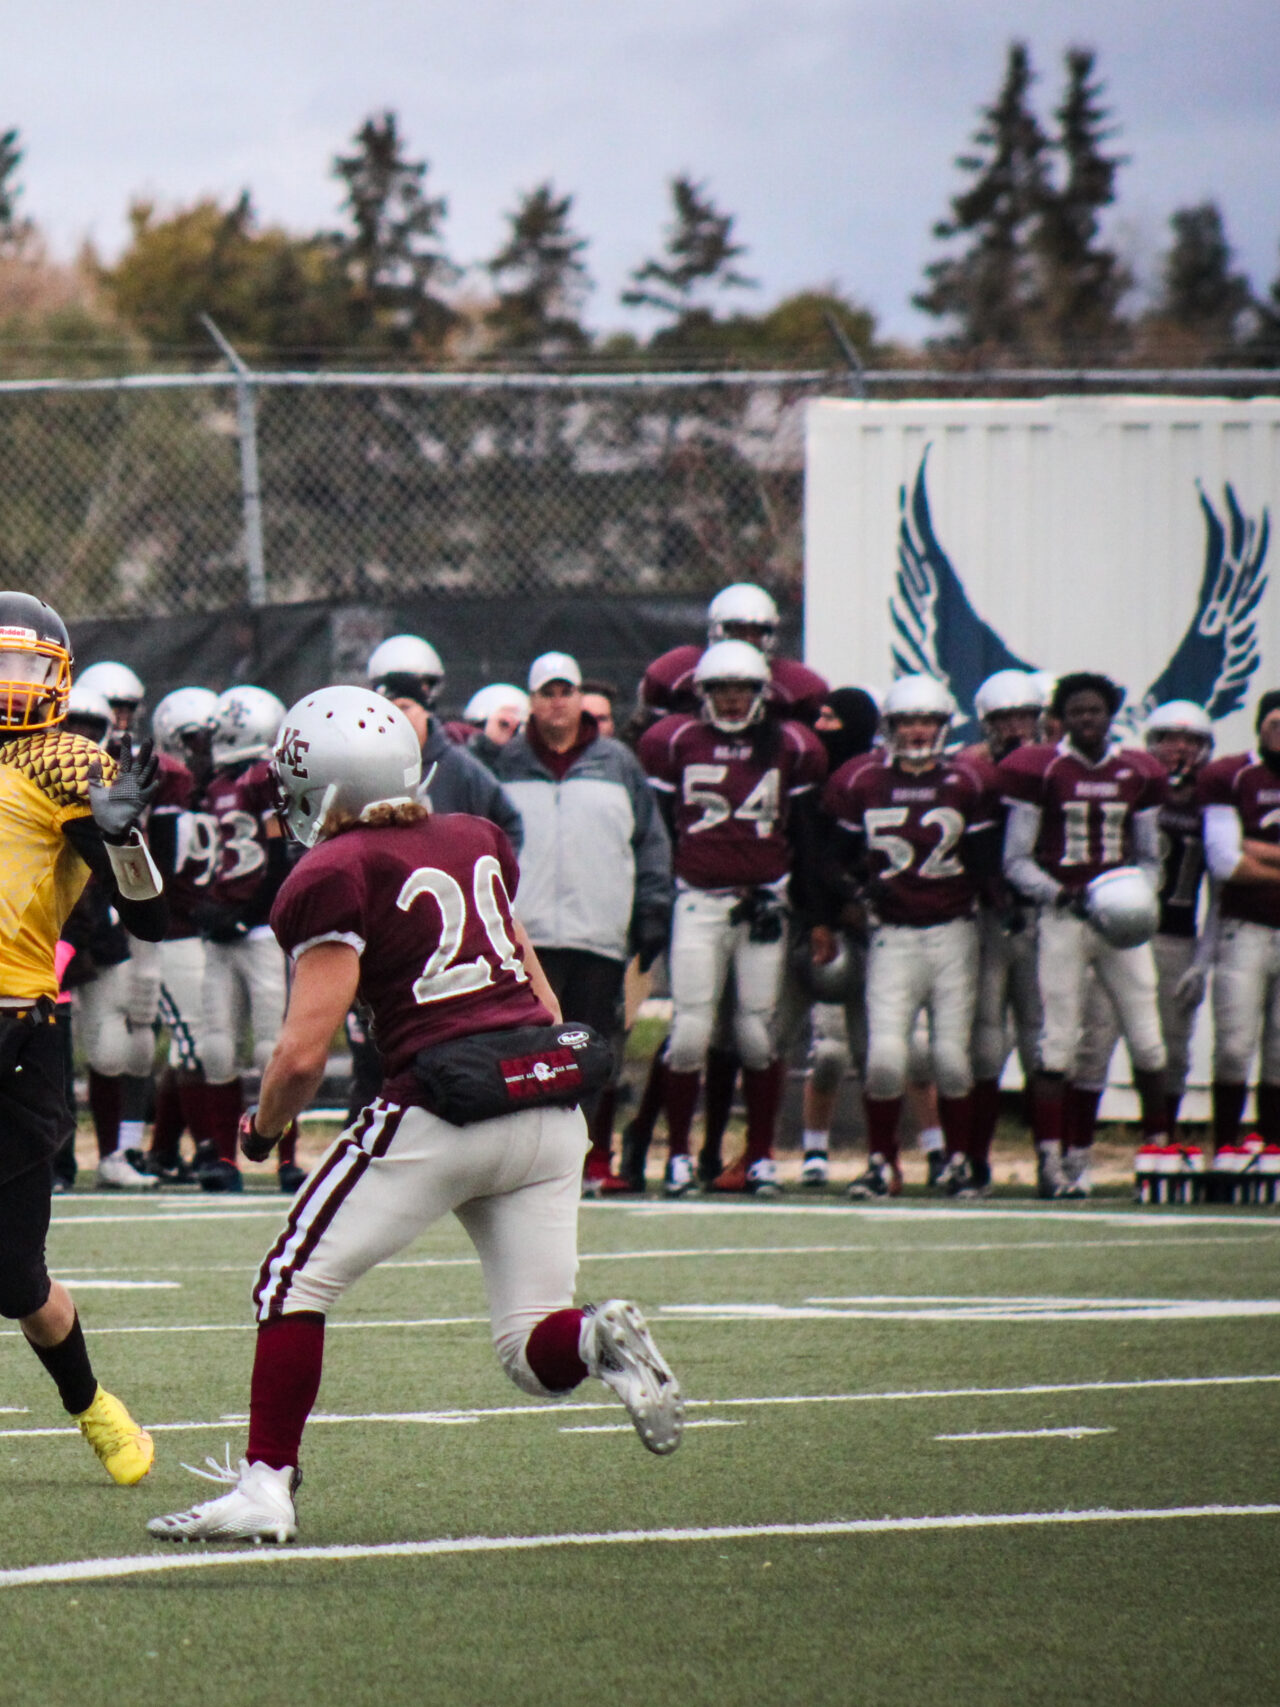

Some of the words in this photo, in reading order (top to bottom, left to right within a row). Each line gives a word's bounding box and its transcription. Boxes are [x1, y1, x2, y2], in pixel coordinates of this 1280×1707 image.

[0, 628, 25, 636] Riddell
[683, 763, 780, 838] 54
[1060, 801, 1128, 866] 11
[188, 810, 265, 885] 93
[864, 807, 965, 879] 52
[396, 855, 529, 1005] 20
